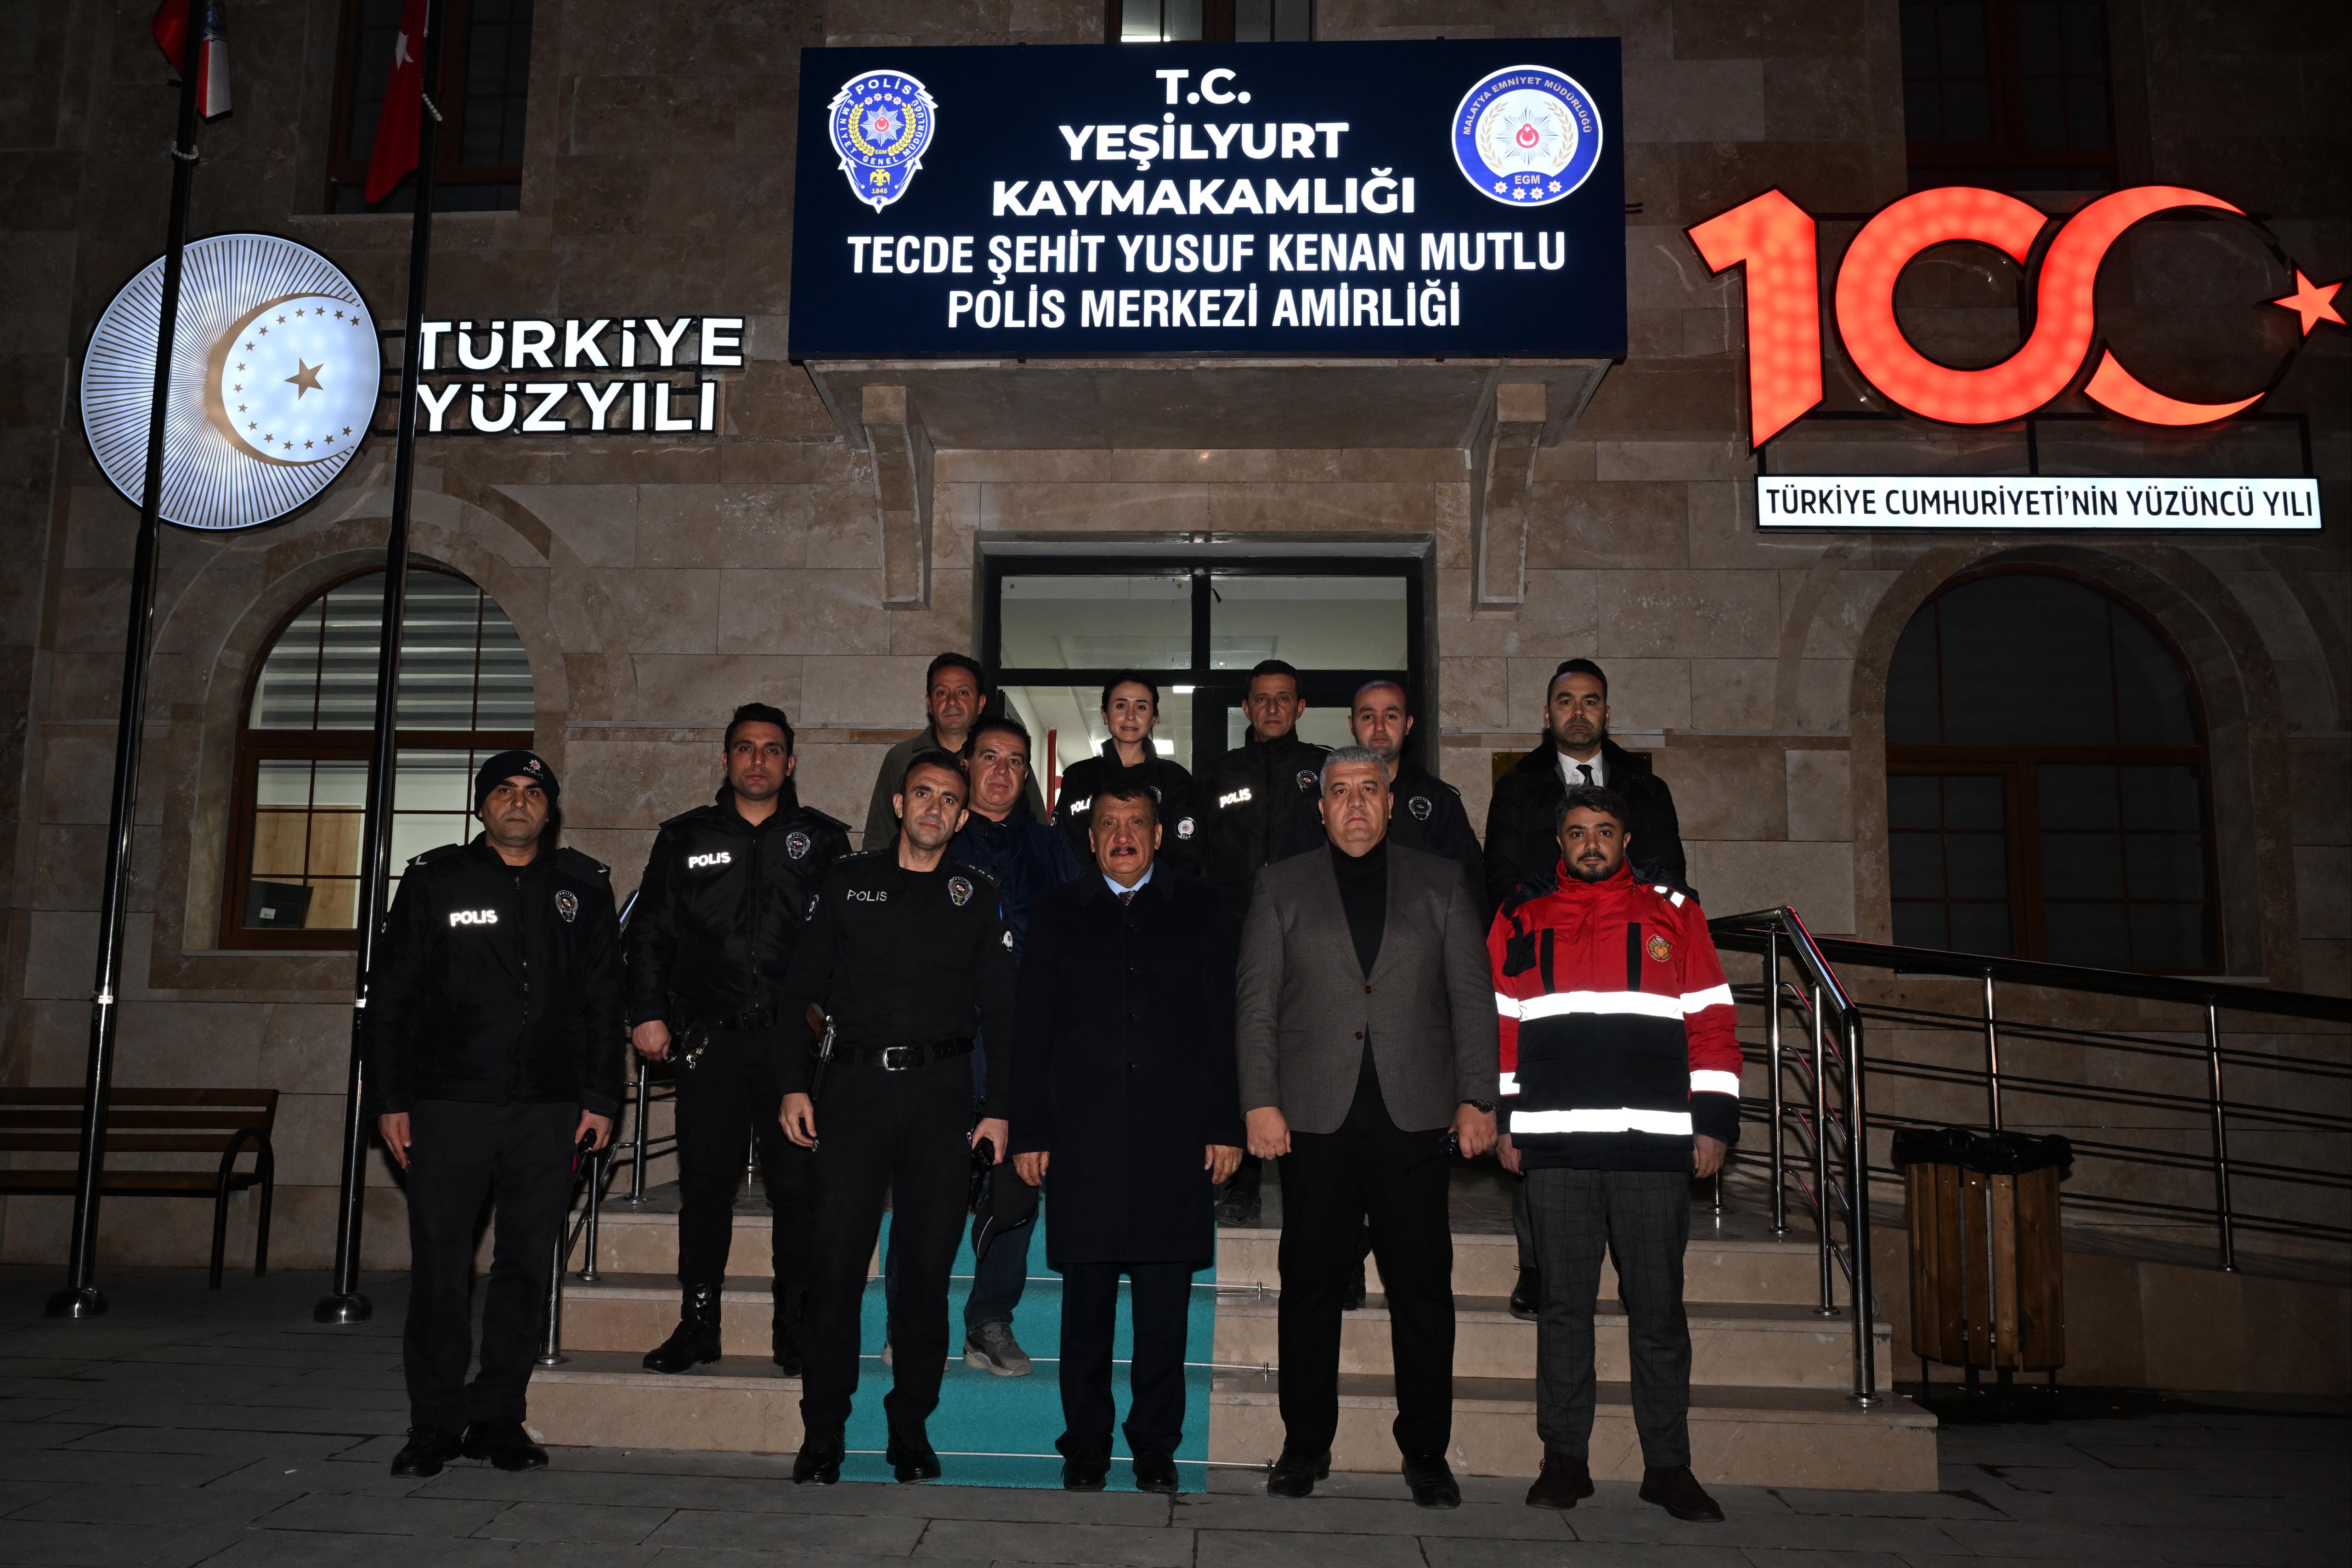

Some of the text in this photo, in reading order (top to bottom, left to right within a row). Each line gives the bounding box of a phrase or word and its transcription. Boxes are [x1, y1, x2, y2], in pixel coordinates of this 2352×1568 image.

[855, 78, 912, 95] POLİS
[1156, 68, 1251, 104] T.C.
[1463, 76, 1591, 135] MALATYA EMNİYET MÜDÜRLÜĞÜ
[840, 99, 925, 165] EMNİYET GENEL MÜDÜRLÜĞÜ
[1059, 113, 1349, 171] YEŞİLYURT
[993, 168, 1414, 215] KAYMAKAMLIĞI
[1515, 175, 1540, 184] EGM
[848, 229, 1565, 284] TECDE ŞEHİT YUSUF KENAN MUTLU
[949, 279, 1459, 328] POLİS MERKEZİ AMİRLİĞİ
[420, 318, 742, 370] TÜRKİYE
[417, 383, 714, 432] YÜZYILI
[1766, 484, 1876, 514] TÜRKİYE
[2126, 486, 2254, 516] YÜZÜNCÜ
[2263, 492, 2312, 516] YILI
